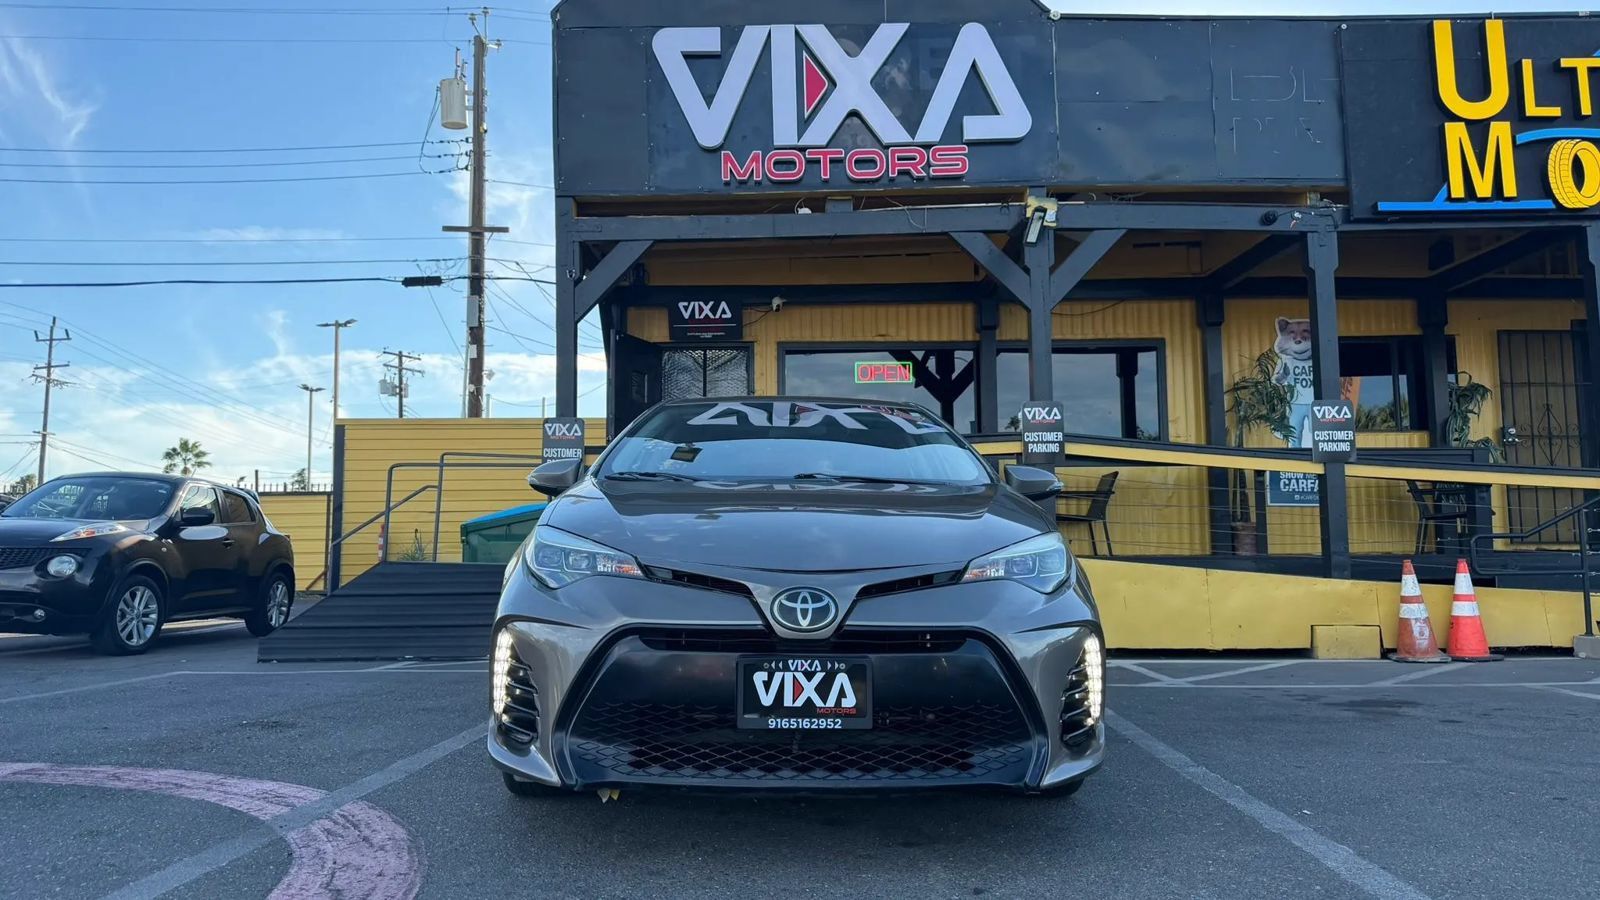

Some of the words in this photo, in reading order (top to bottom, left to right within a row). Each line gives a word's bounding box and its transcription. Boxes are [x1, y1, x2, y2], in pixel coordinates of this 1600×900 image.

[652, 22, 1032, 149] VIXA
[721, 145, 970, 184] MOTORS
[678, 301, 732, 319] VIXA
[858, 364, 910, 382] OPEN
[1024, 407, 1061, 420] VIXA
[1313, 406, 1352, 419] VIXA
[544, 423, 582, 436] VIXA
[1314, 430, 1353, 440] CUSTOMER
[1024, 432, 1063, 442] CUSTOMER
[543, 448, 582, 458] CUSTOMER
[1028, 443, 1060, 453] PARKING
[1319, 442, 1350, 452] PARKING
[788, 659, 822, 671] VIXA
[752, 671, 857, 708] VIXA
[768, 718, 842, 729] 9165162952
